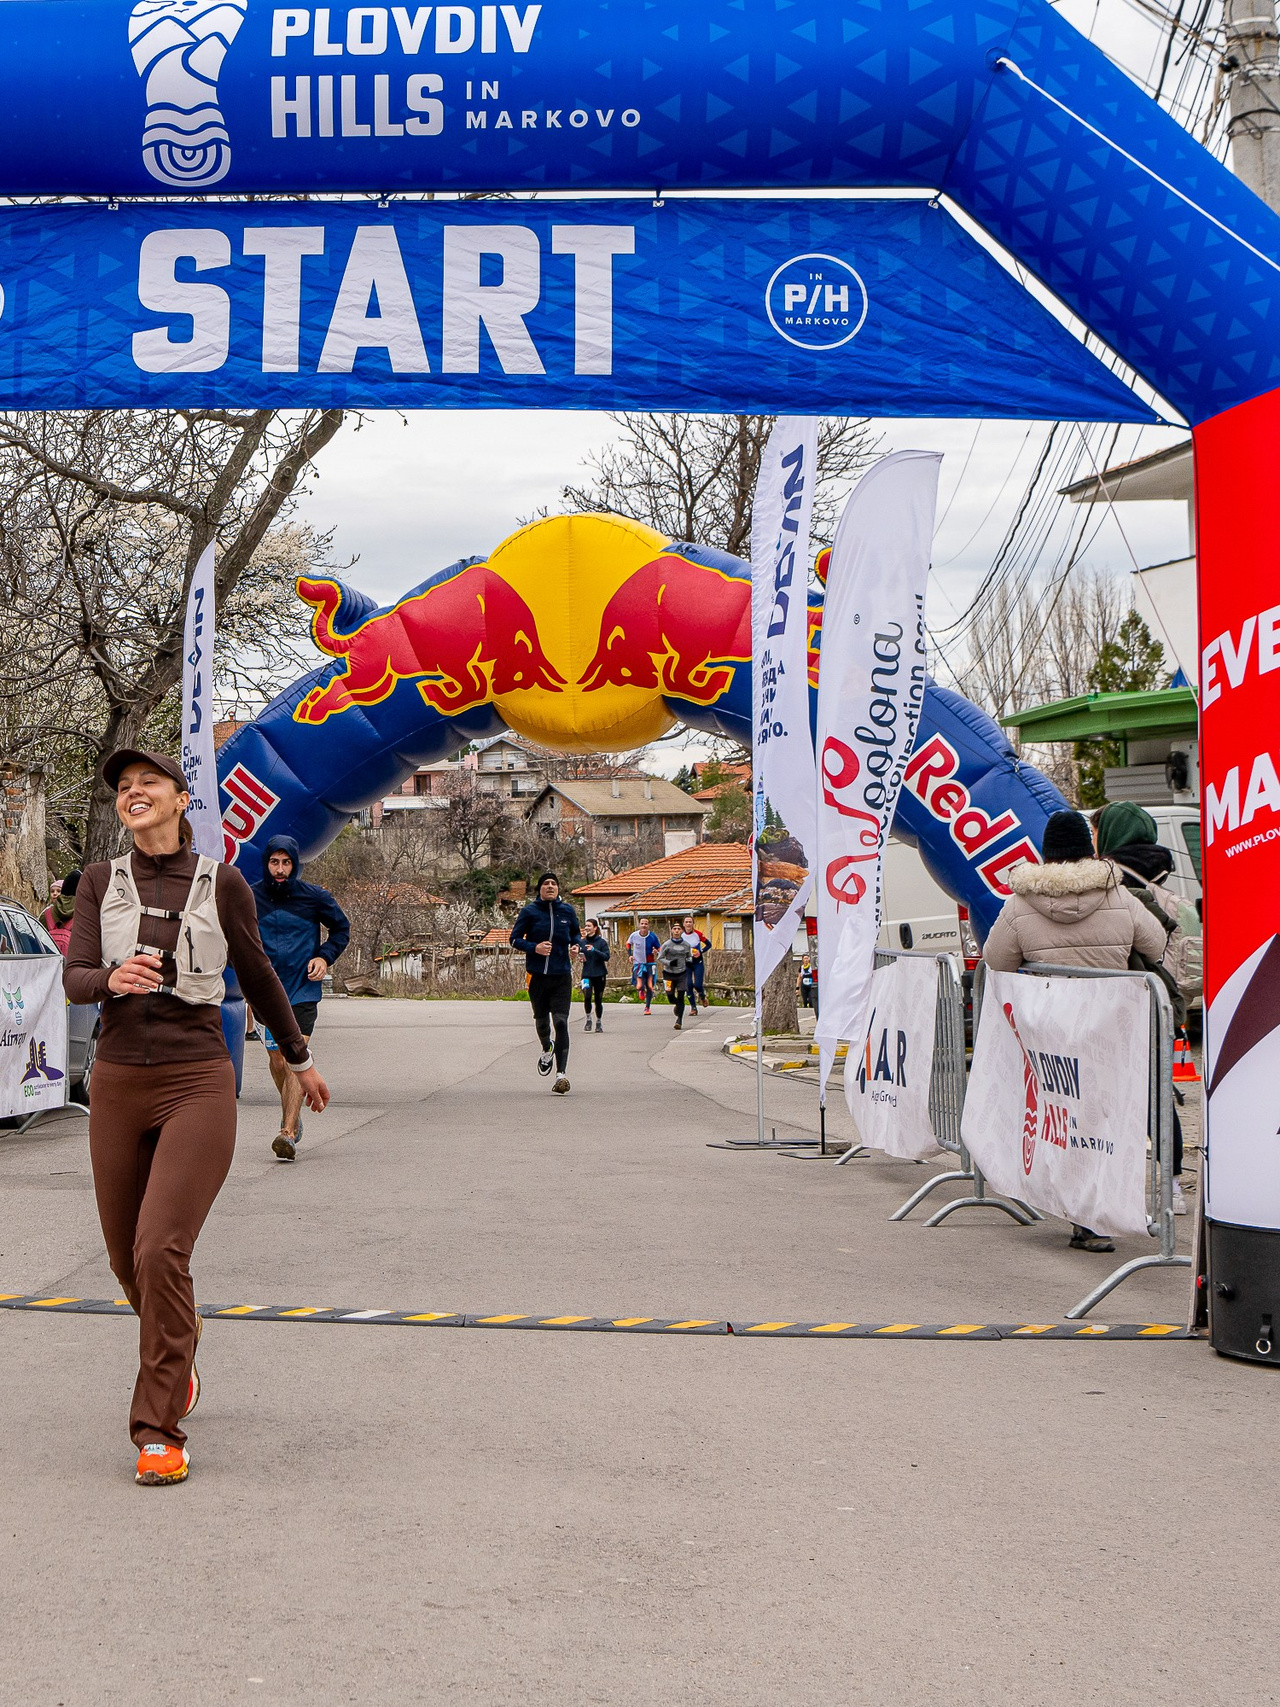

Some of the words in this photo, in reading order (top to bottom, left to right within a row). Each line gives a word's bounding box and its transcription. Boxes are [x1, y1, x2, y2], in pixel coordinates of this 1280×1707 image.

[271, 4, 542, 57] PLOVDIV
[466, 80, 499, 100] IN
[271, 73, 444, 138] HILLS
[466, 108, 642, 130] MARKOVO
[809, 273, 823, 281] IN
[131, 225, 636, 376] START
[784, 284, 849, 315] P/H
[785, 317, 849, 326] MARKOVO
[903, 738, 1015, 855] Red
[921, 931, 958, 940] DUCATO
[23, 1085, 34, 1098] ECO
[1069, 1115, 1078, 1130] IN
